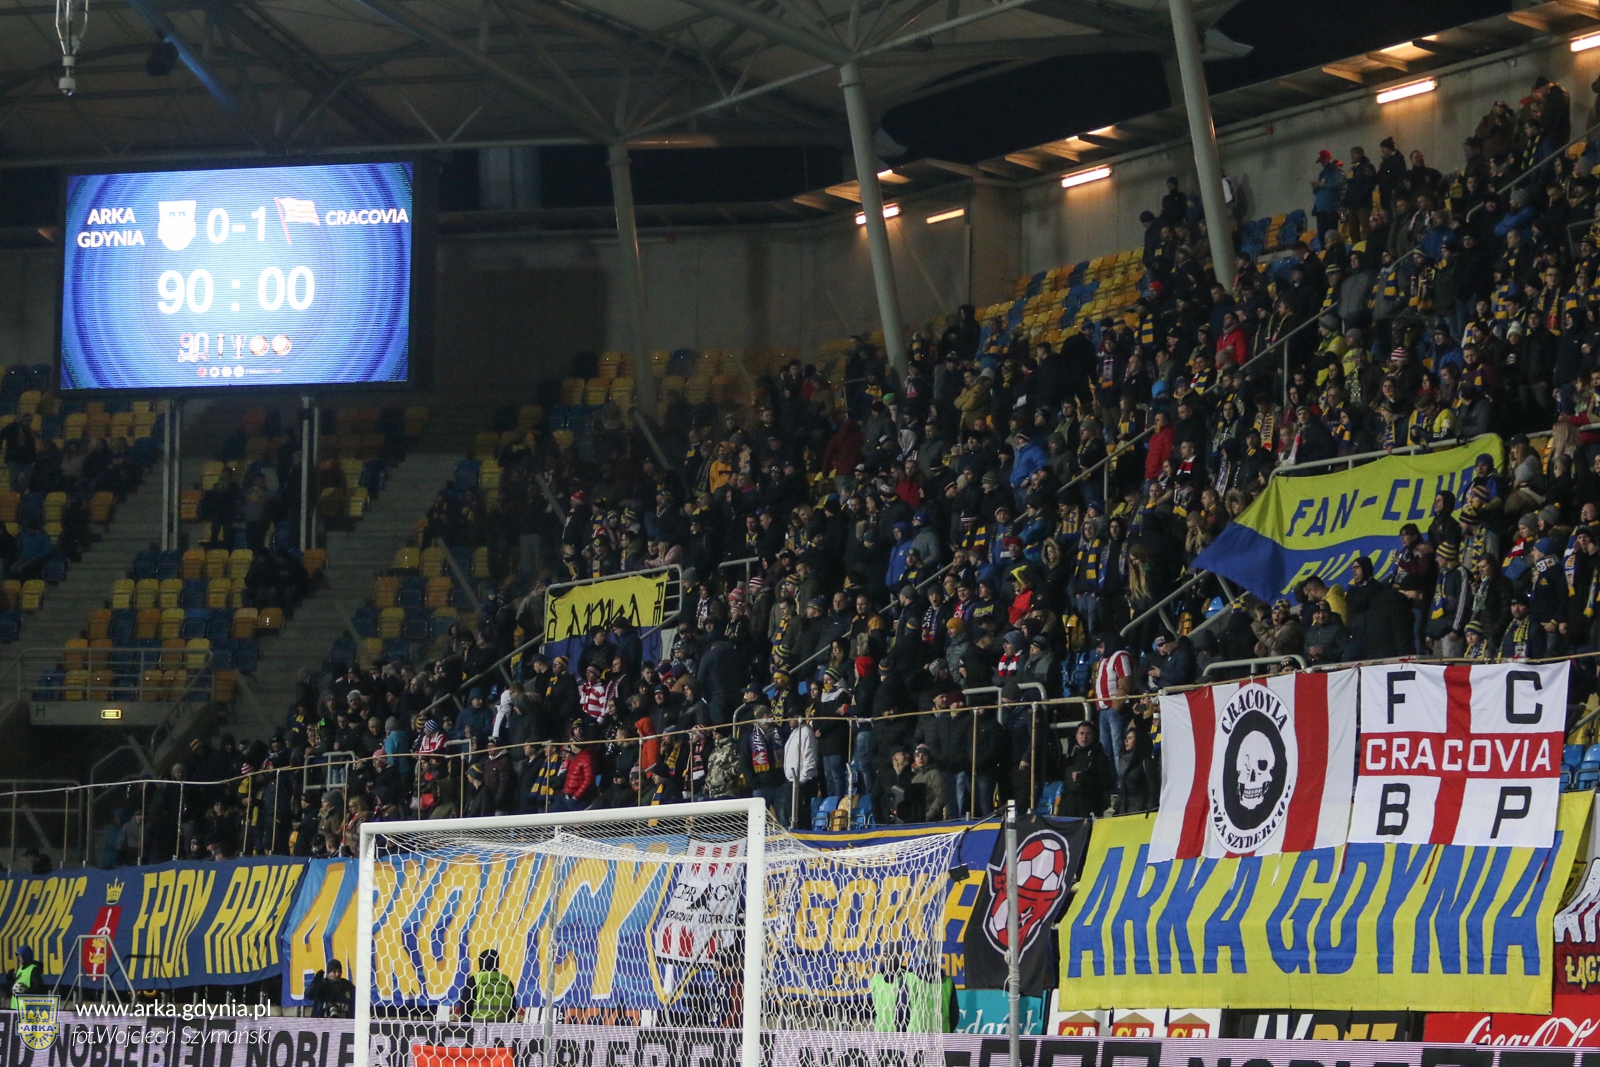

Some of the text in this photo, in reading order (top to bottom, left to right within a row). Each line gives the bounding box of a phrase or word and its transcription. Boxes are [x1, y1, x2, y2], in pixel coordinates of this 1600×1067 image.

[87, 207, 136, 225] ARKA
[325, 208, 410, 226] CRACOVIA
[77, 229, 146, 248] GDYNIA
[1221, 689, 1288, 735] CRACOVIA
[1386, 670, 1543, 725] F C
[1365, 738, 1551, 771] CRACOVIA
[1376, 783, 1532, 839] B P
[128, 869, 217, 980] FROM
[1067, 843, 1263, 979] ARKA
[1267, 830, 1564, 977] GDYNIA
[1565, 955, 1600, 990] ŁĄC
